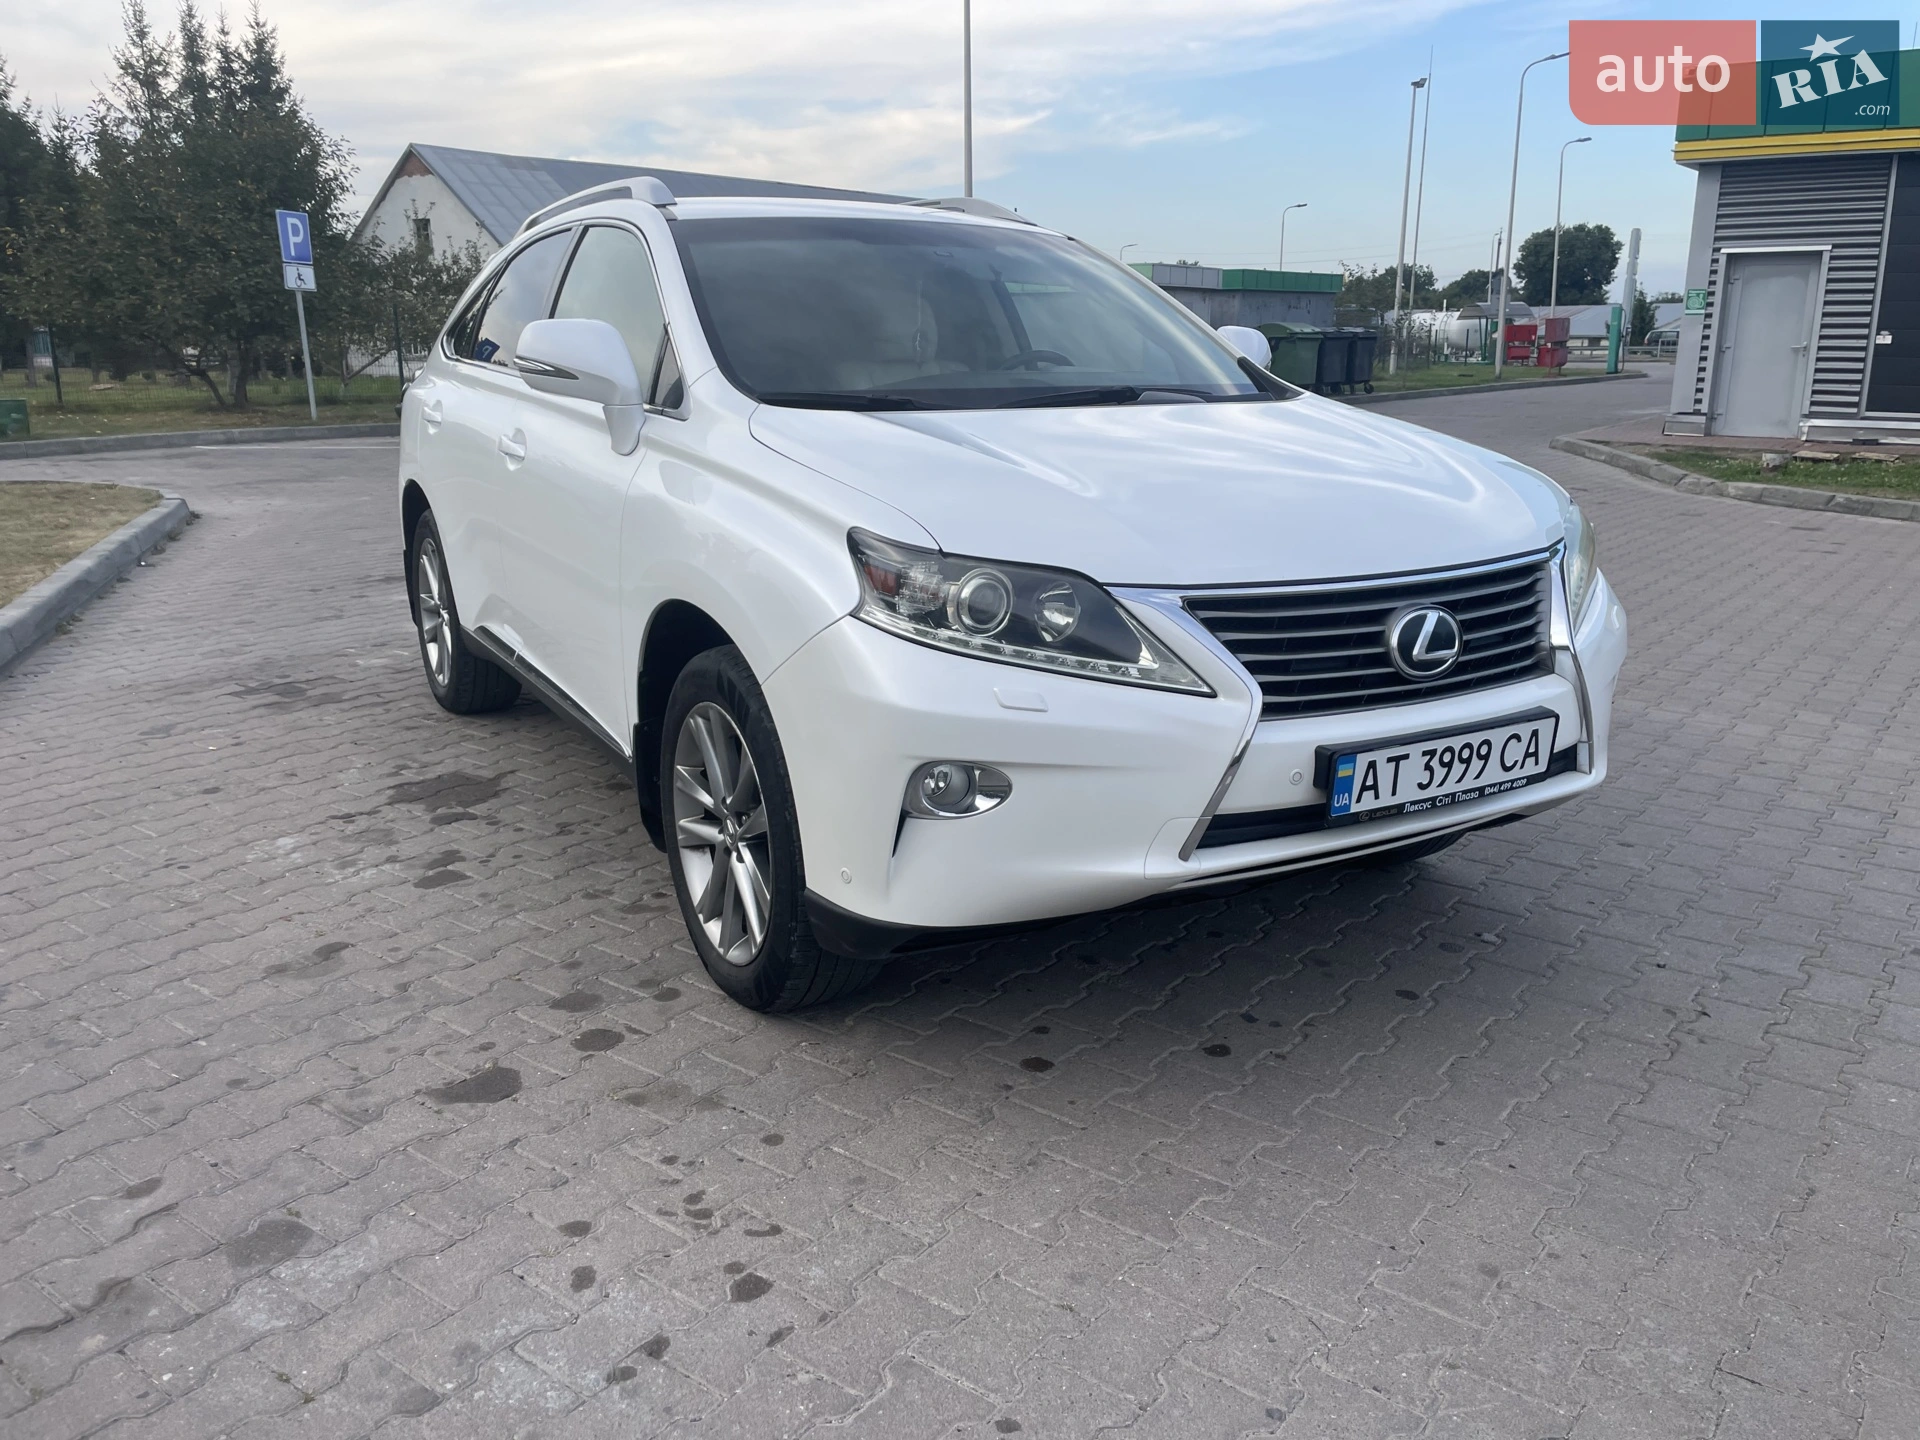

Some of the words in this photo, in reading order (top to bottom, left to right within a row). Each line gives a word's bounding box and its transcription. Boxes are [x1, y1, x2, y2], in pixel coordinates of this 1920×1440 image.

[286, 217, 304, 257] P
[1355, 752, 1410, 804] AT
[1417, 738, 1493, 791] 3999
[1500, 728, 1541, 773] CA
[1334, 792, 1350, 807] UA
